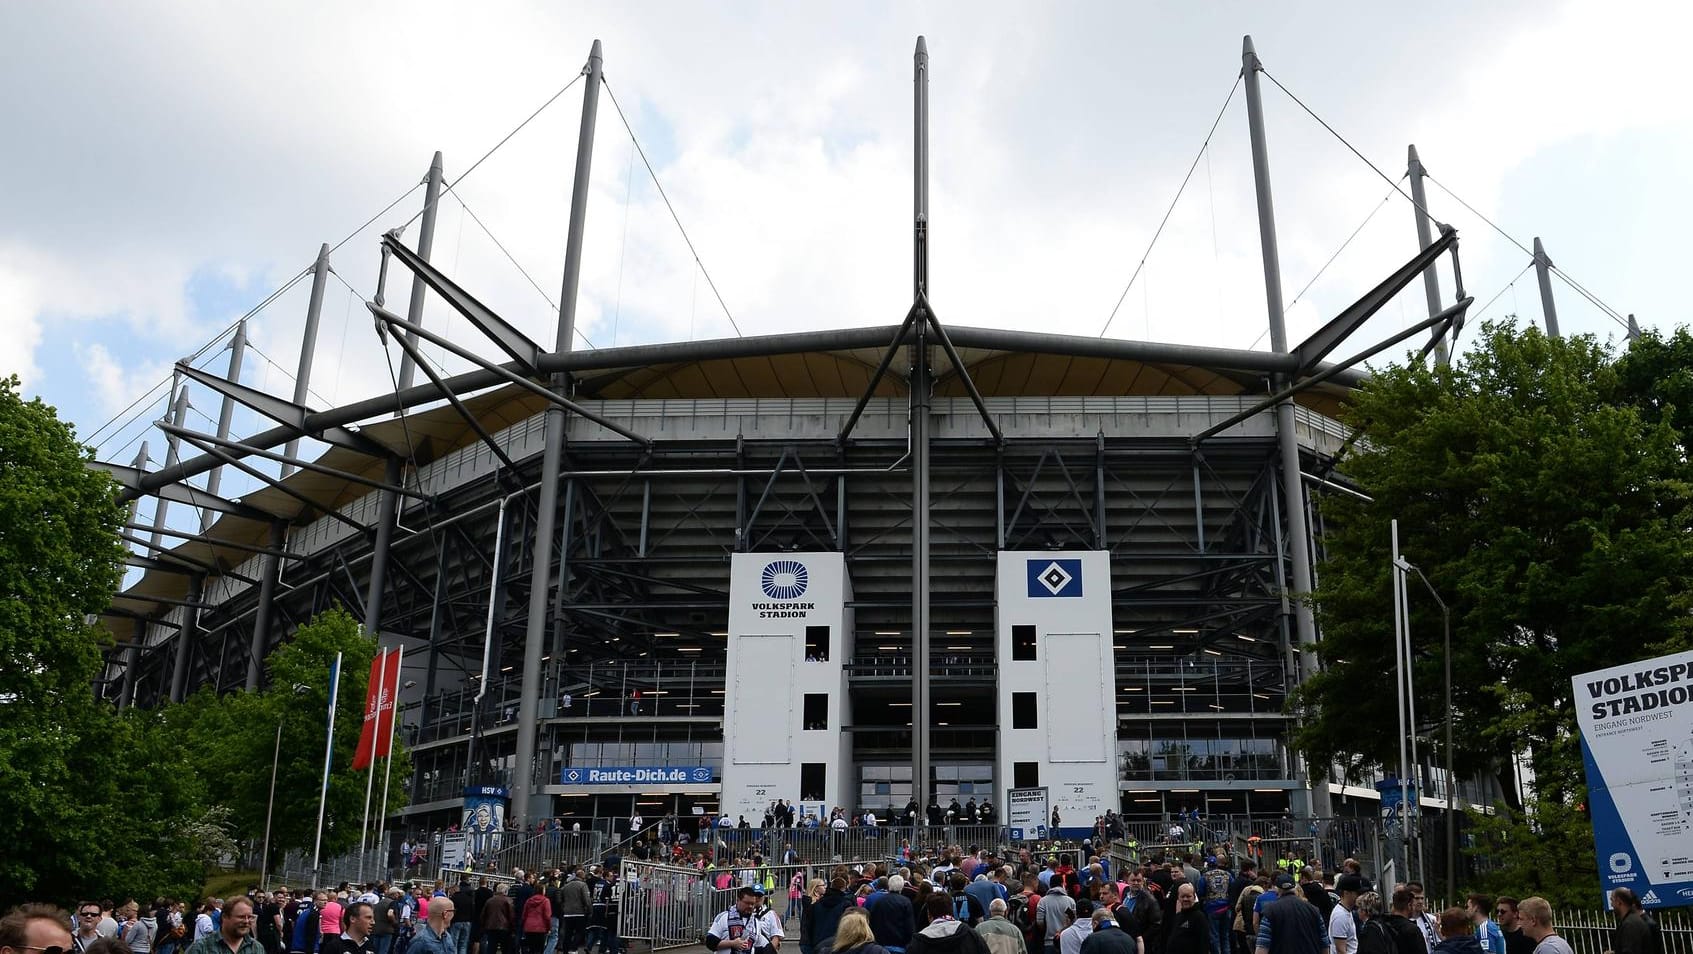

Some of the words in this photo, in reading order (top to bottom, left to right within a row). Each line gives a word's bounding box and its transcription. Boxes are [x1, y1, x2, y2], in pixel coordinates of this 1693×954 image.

[1594, 719, 1628, 731] EINGANG
[1629, 710, 1673, 725] NORDWEST
[589, 768, 687, 782] Raute-Dich.de
[481, 786, 496, 794] HSV
